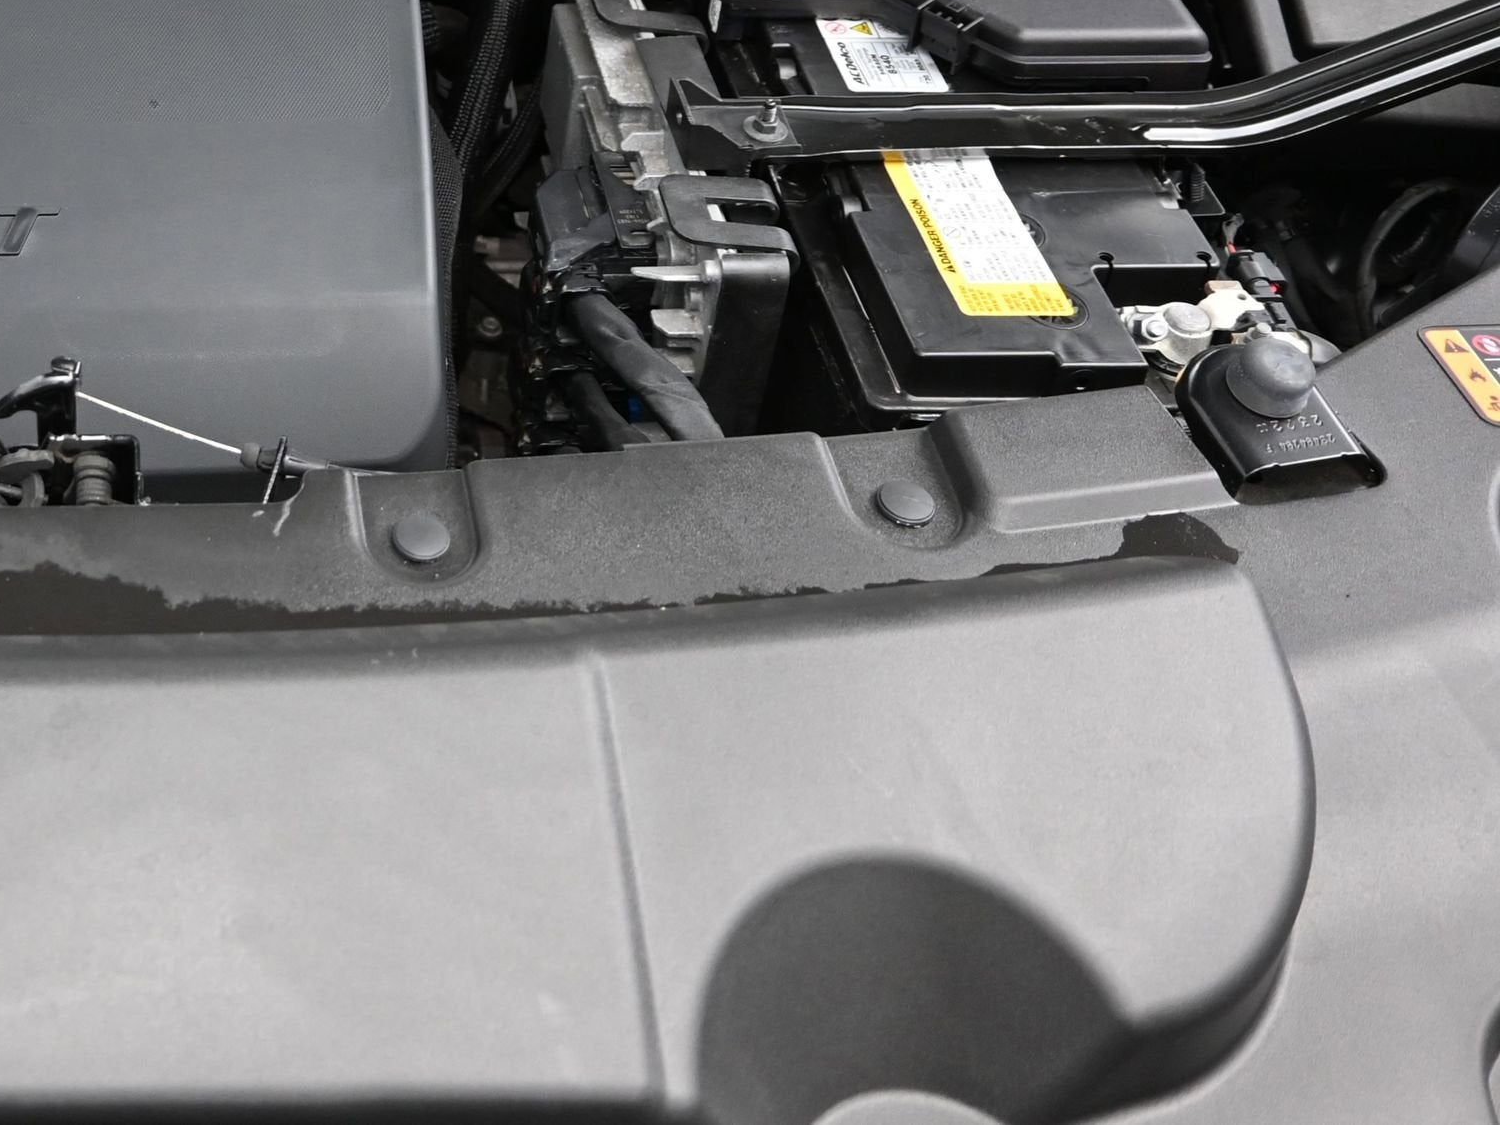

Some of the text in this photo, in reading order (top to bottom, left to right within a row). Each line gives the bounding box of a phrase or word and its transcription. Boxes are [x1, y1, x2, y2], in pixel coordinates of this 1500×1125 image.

[837, 41, 865, 85] ACDelco
[908, 197, 954, 266] DANGER POISON
